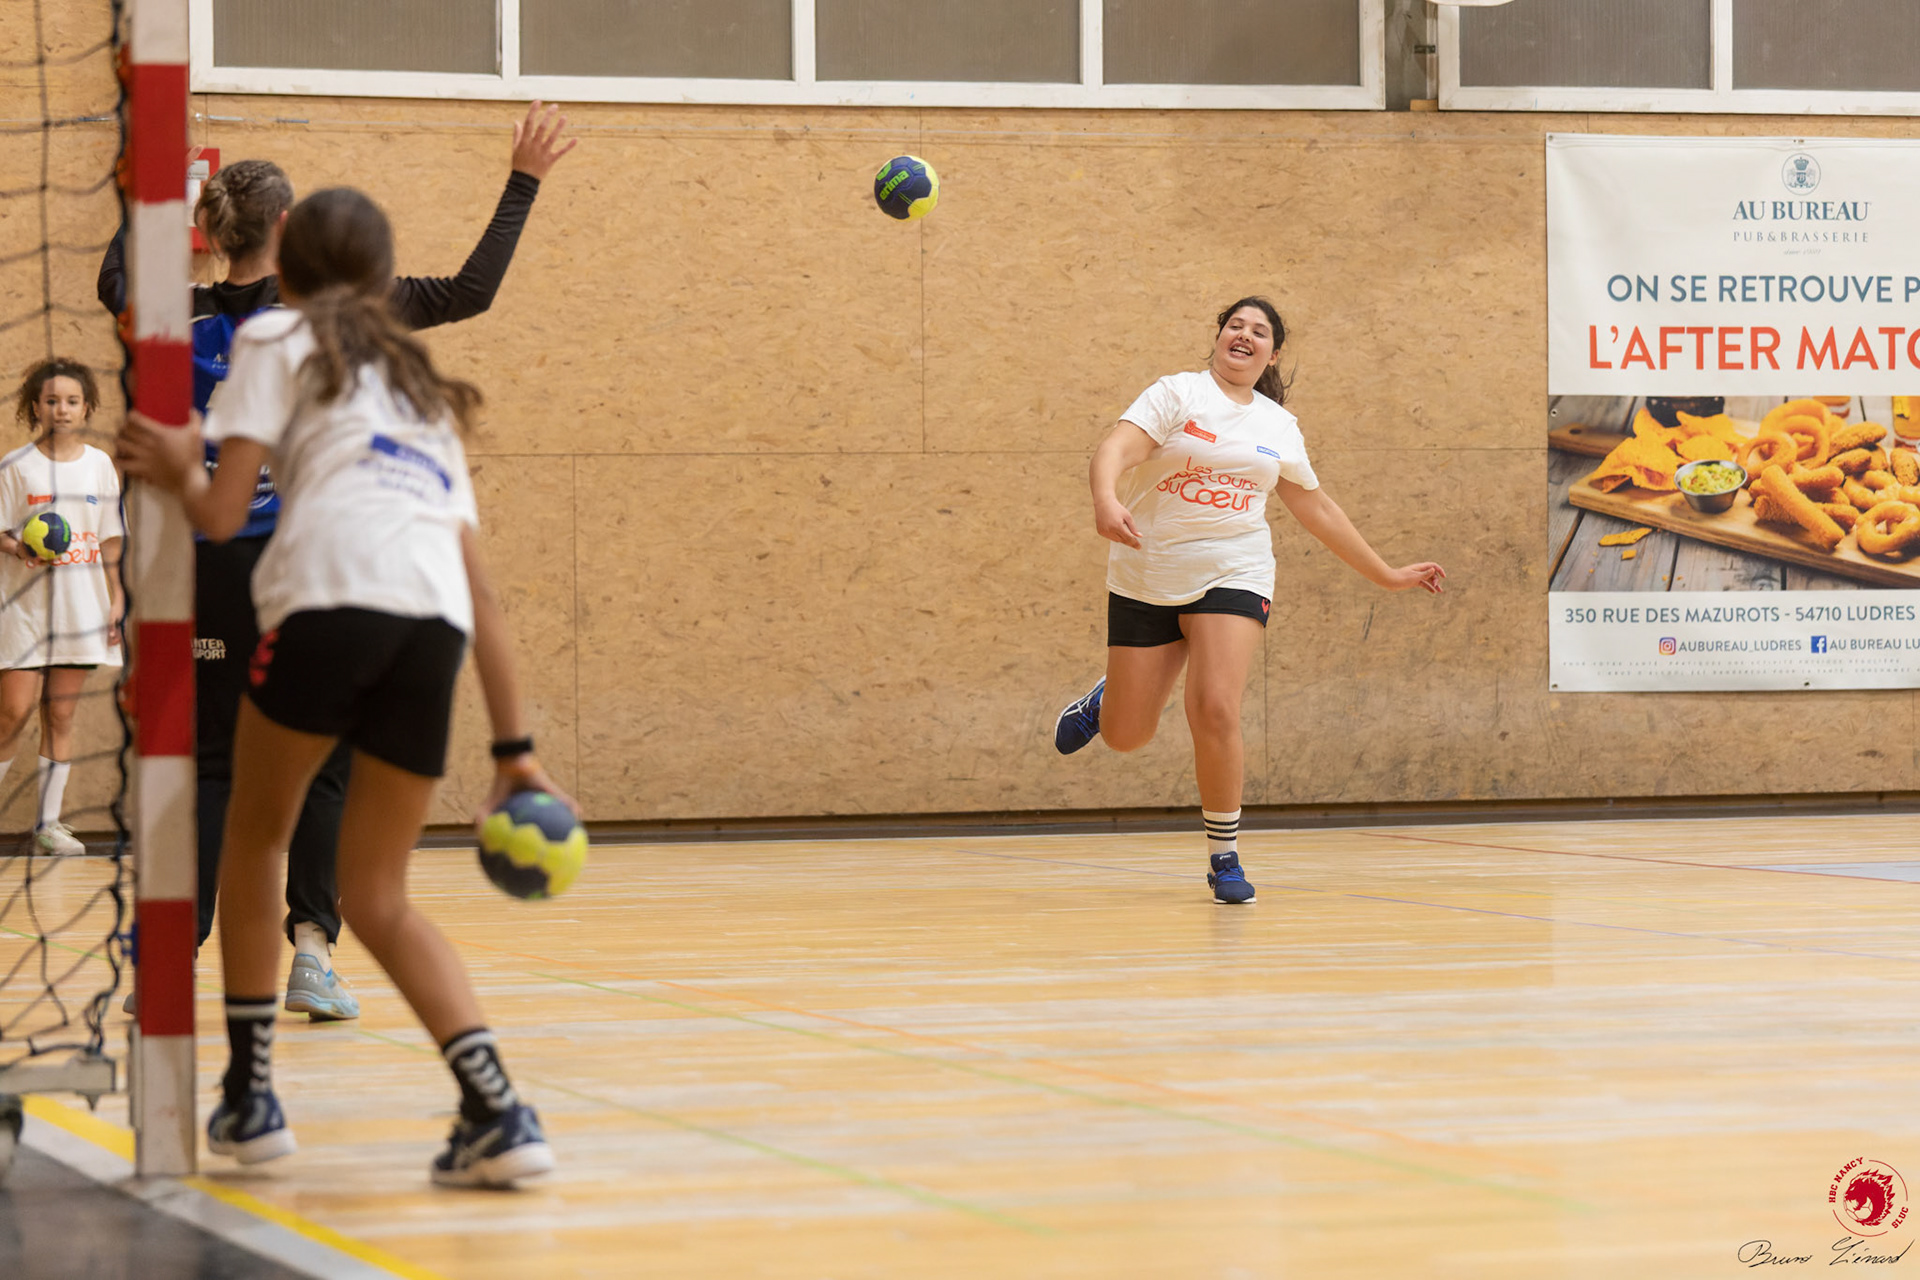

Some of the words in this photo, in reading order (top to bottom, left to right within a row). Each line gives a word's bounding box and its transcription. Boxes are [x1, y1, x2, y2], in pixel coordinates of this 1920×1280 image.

[879, 170, 910, 201] erima
[1732, 200, 1766, 221] AU
[1772, 201, 1869, 221] BUREAU
[1733, 231, 1869, 243] PUB&BRASSERIE
[1606, 274, 1659, 303] ON
[1669, 274, 1708, 303] SE
[1718, 274, 1893, 303] RETROUVE
[1588, 325, 1781, 371] L’AFTER
[1185, 456, 1213, 475] Les
[1565, 607, 1597, 623] 350
[1603, 607, 1640, 623] RUE
[1646, 607, 1680, 623] DES
[1685, 606, 1780, 623] MAZUROTS
[1795, 606, 1842, 622] 54710
[1847, 605, 1916, 621] LUDRES
[1679, 640, 1802, 653] AUBUREAU_LUDRES
[1829, 639, 1847, 650] AU
[1850, 639, 1902, 650] BUREAU
